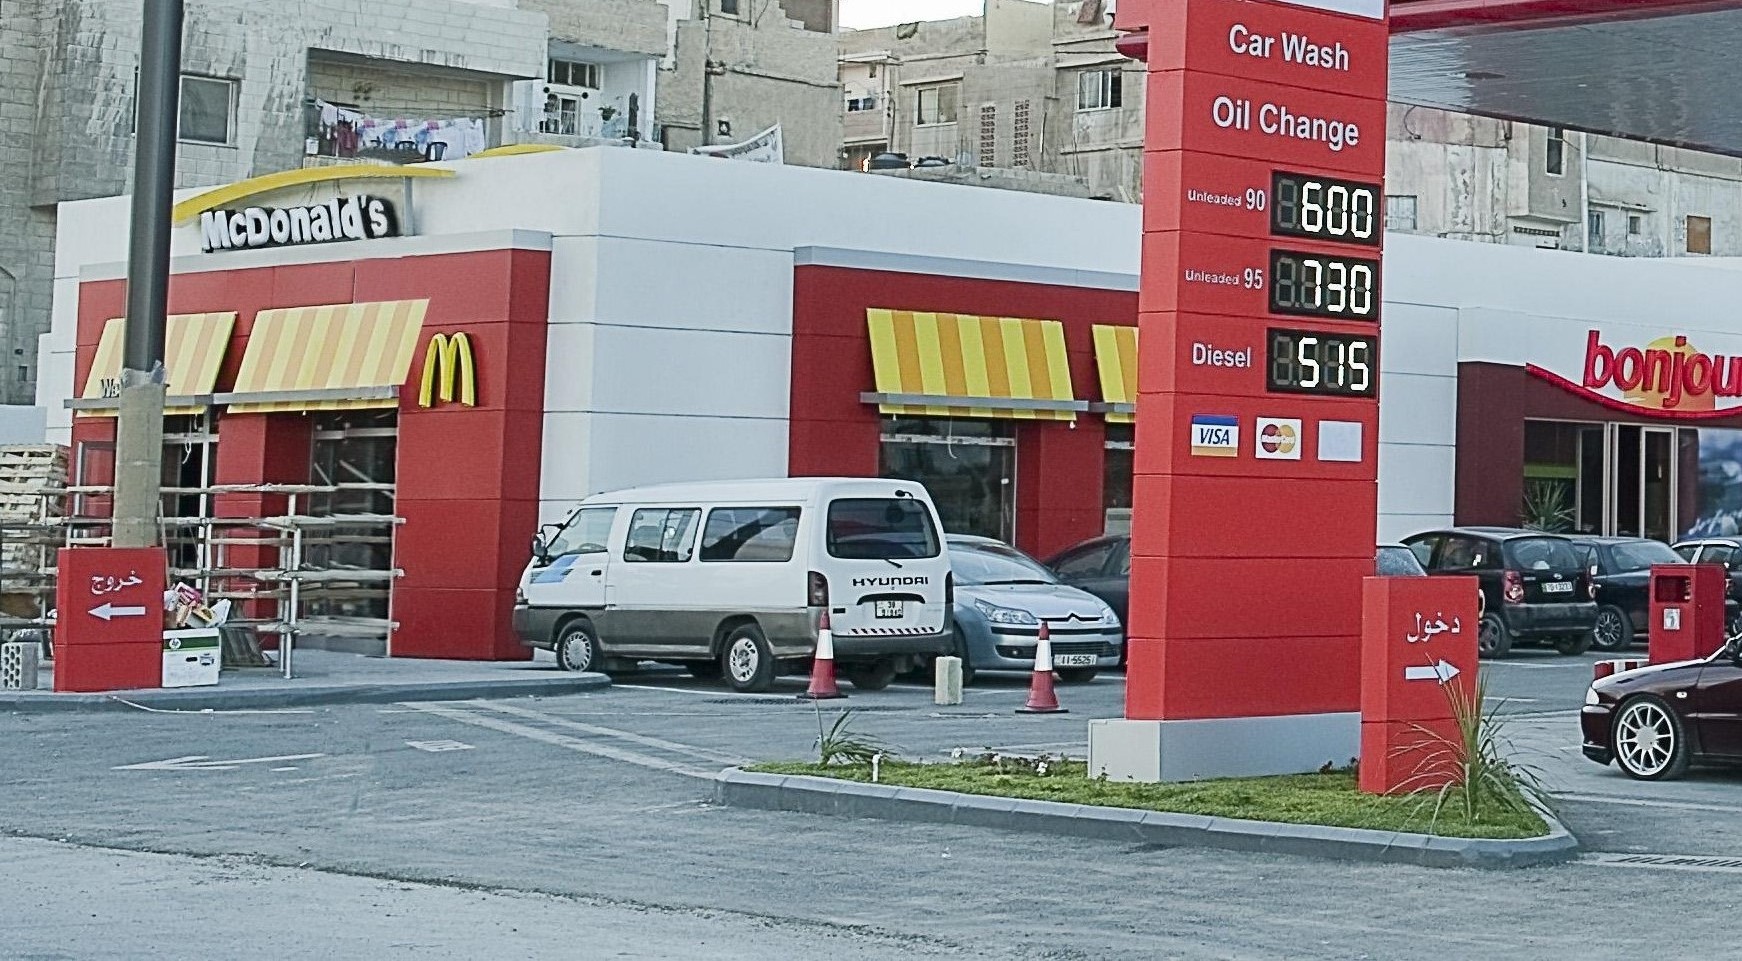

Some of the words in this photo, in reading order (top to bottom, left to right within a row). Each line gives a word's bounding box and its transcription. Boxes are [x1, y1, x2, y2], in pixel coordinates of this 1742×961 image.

[1229, 23, 1275, 58] Car
[1281, 32, 1349, 71] Wash
[1212, 96, 1250, 131] Oil
[1259, 103, 1359, 152] Change
[200, 195, 389, 250] McDonald's
[1187, 189, 1242, 207] Unleaded
[1245, 187, 1266, 211] 90
[1301, 181, 1373, 239] 600
[1185, 269, 1240, 285] Unleaded
[1244, 267, 1263, 289] 95
[1303, 259, 1372, 315] 730
[1192, 342, 1251, 368] Diesel
[1297, 336, 1369, 391] 515
[1200, 427, 1230, 446] VISA
[91, 570, 143, 595] خروج
[852, 577, 929, 587] HYUNDAI
[1406, 612, 1460, 643] دخول
